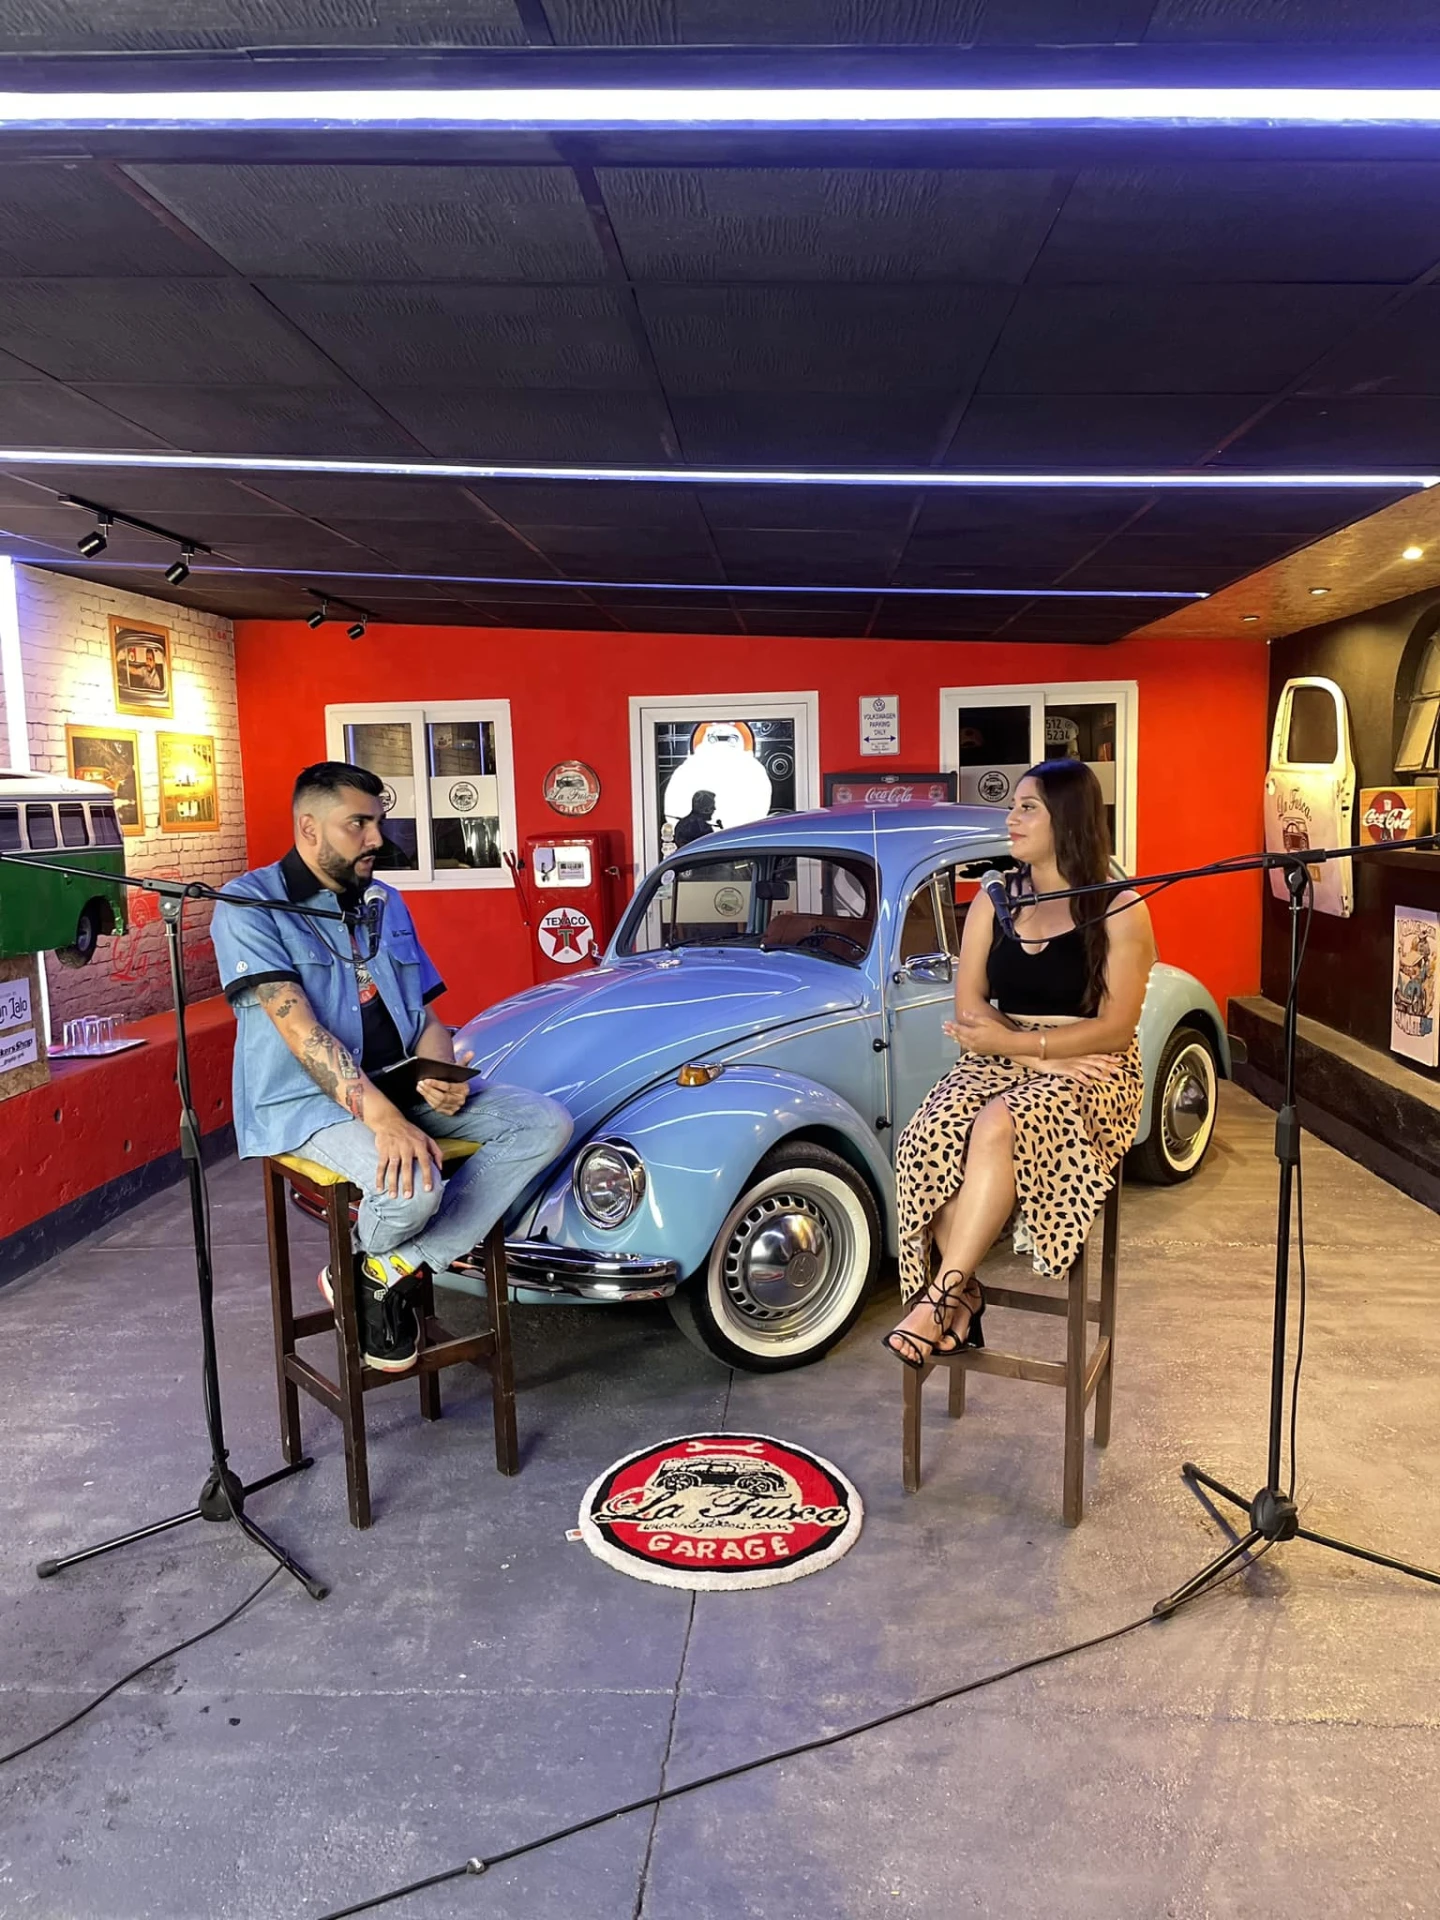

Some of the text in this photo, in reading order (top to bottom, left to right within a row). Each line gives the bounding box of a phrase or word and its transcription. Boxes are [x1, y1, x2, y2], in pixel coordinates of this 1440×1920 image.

[1046, 719, 1061, 729] 512
[1047, 730, 1070, 741] 5234
[545, 916, 586, 926] TEXACO
[593, 1489, 848, 1521] La Fusca
[648, 1533, 790, 1560] GARAGE
